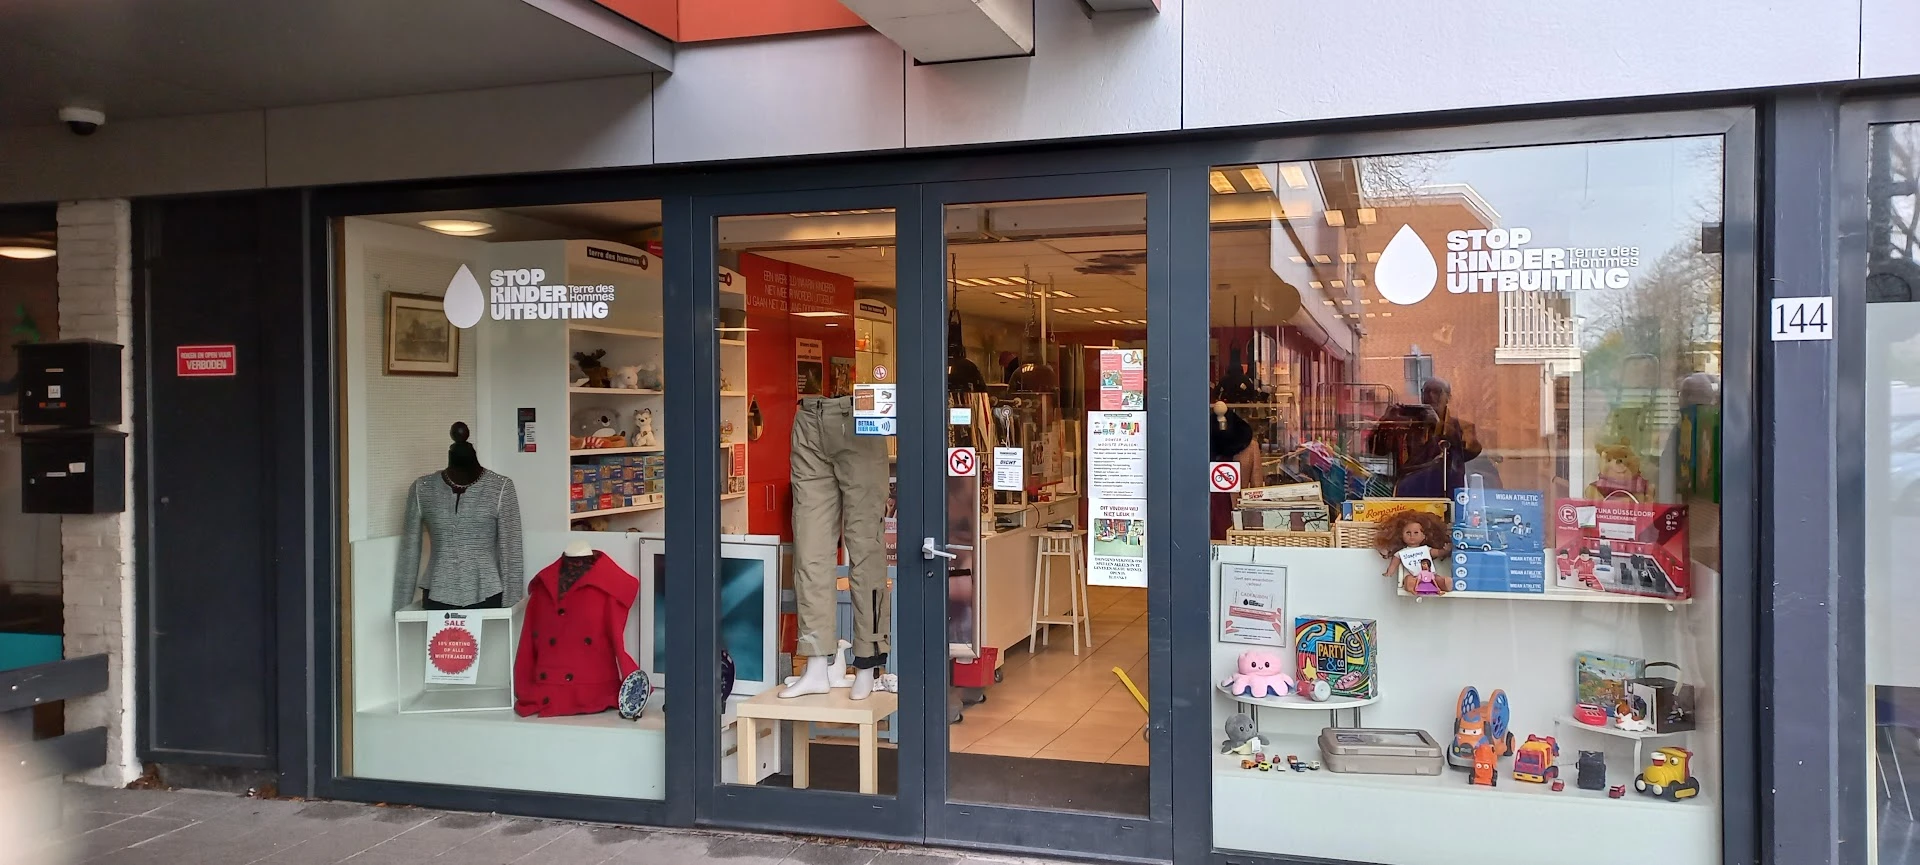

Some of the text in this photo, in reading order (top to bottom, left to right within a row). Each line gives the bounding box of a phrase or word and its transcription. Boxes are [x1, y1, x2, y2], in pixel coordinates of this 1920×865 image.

[1446, 227, 1532, 251] STOP
[588, 249, 640, 265] terre des hommes
[1568, 245, 1640, 258] Terre des
[1446, 248, 1565, 272] KINDER
[1569, 256, 1640, 269] Hommes
[490, 268, 546, 287] STOP
[1446, 268, 1630, 294] UITBUITING
[490, 285, 567, 304] KINDER
[568, 283, 615, 293] Terre des
[569, 292, 615, 302] Hommes
[490, 302, 609, 321] UITBUITING
[1776, 302, 1828, 334] 144
[186, 359, 228, 370] VERBODEN
[1495, 493, 1513, 501] WIGAN
[1365, 503, 1407, 518] Romantic
[1612, 508, 1656, 518] DÜSSELDORF
[1318, 643, 1345, 659] PARTY
[1326, 657, 1345, 671] & CO
